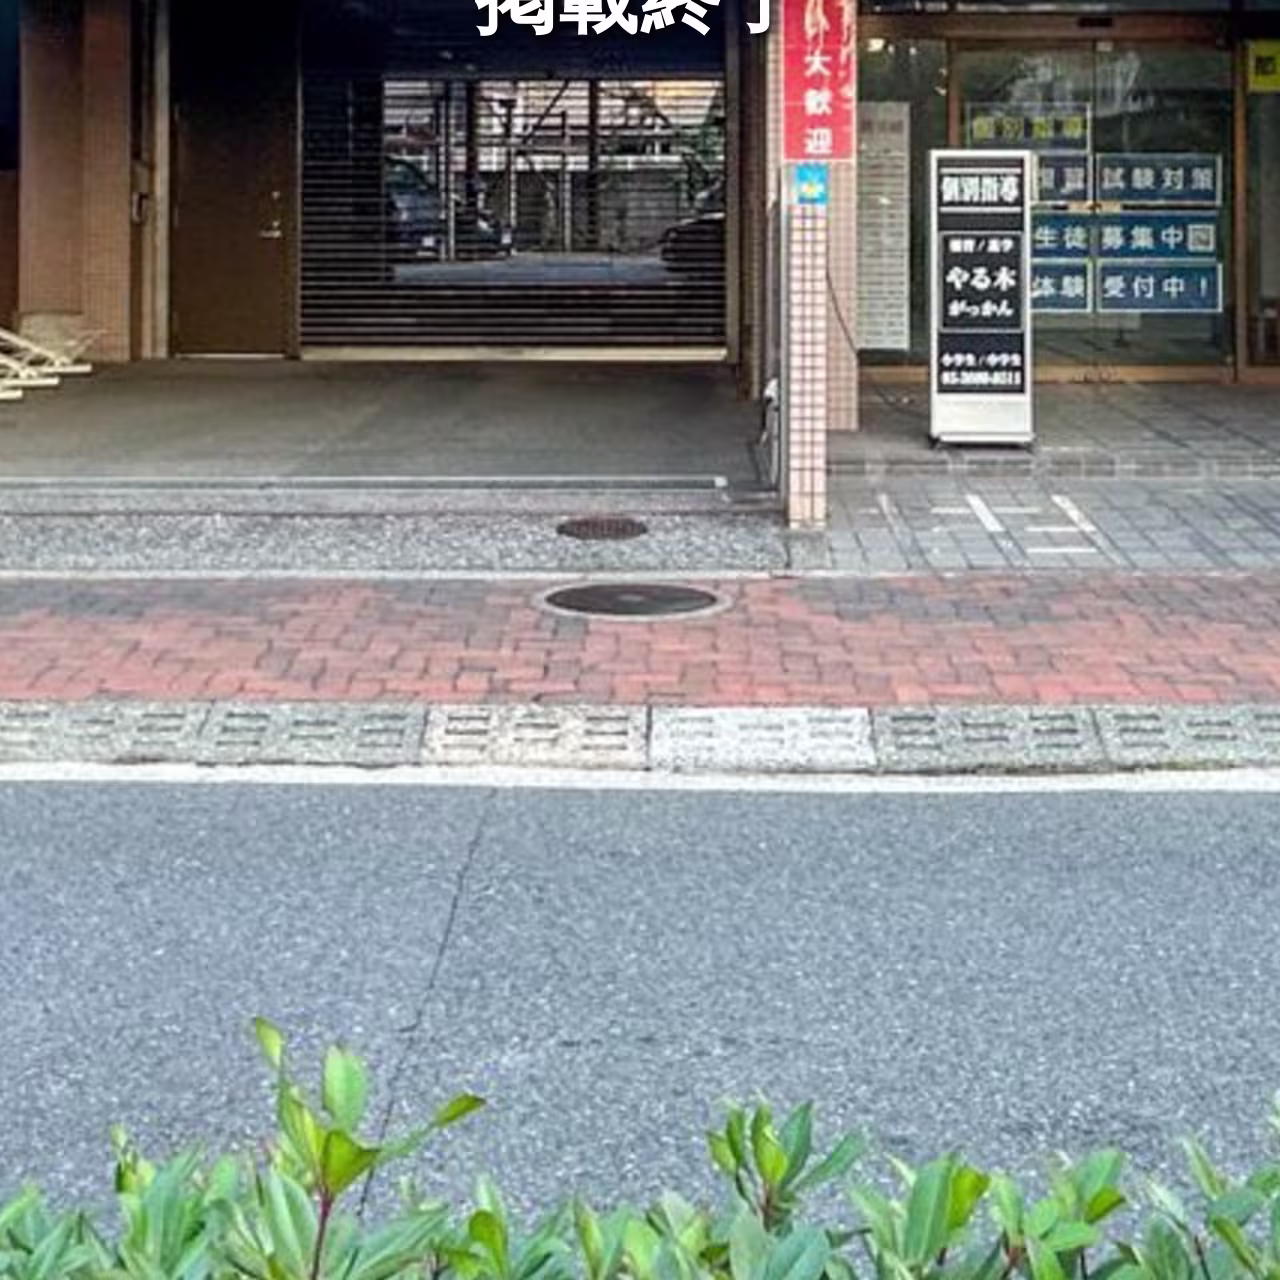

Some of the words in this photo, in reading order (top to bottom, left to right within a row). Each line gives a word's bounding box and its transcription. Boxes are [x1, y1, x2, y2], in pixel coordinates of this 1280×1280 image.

[941, 175, 1020, 203] 個別指導
[945, 266, 1017, 292] やる木
[947, 299, 1014, 317] がっかん
